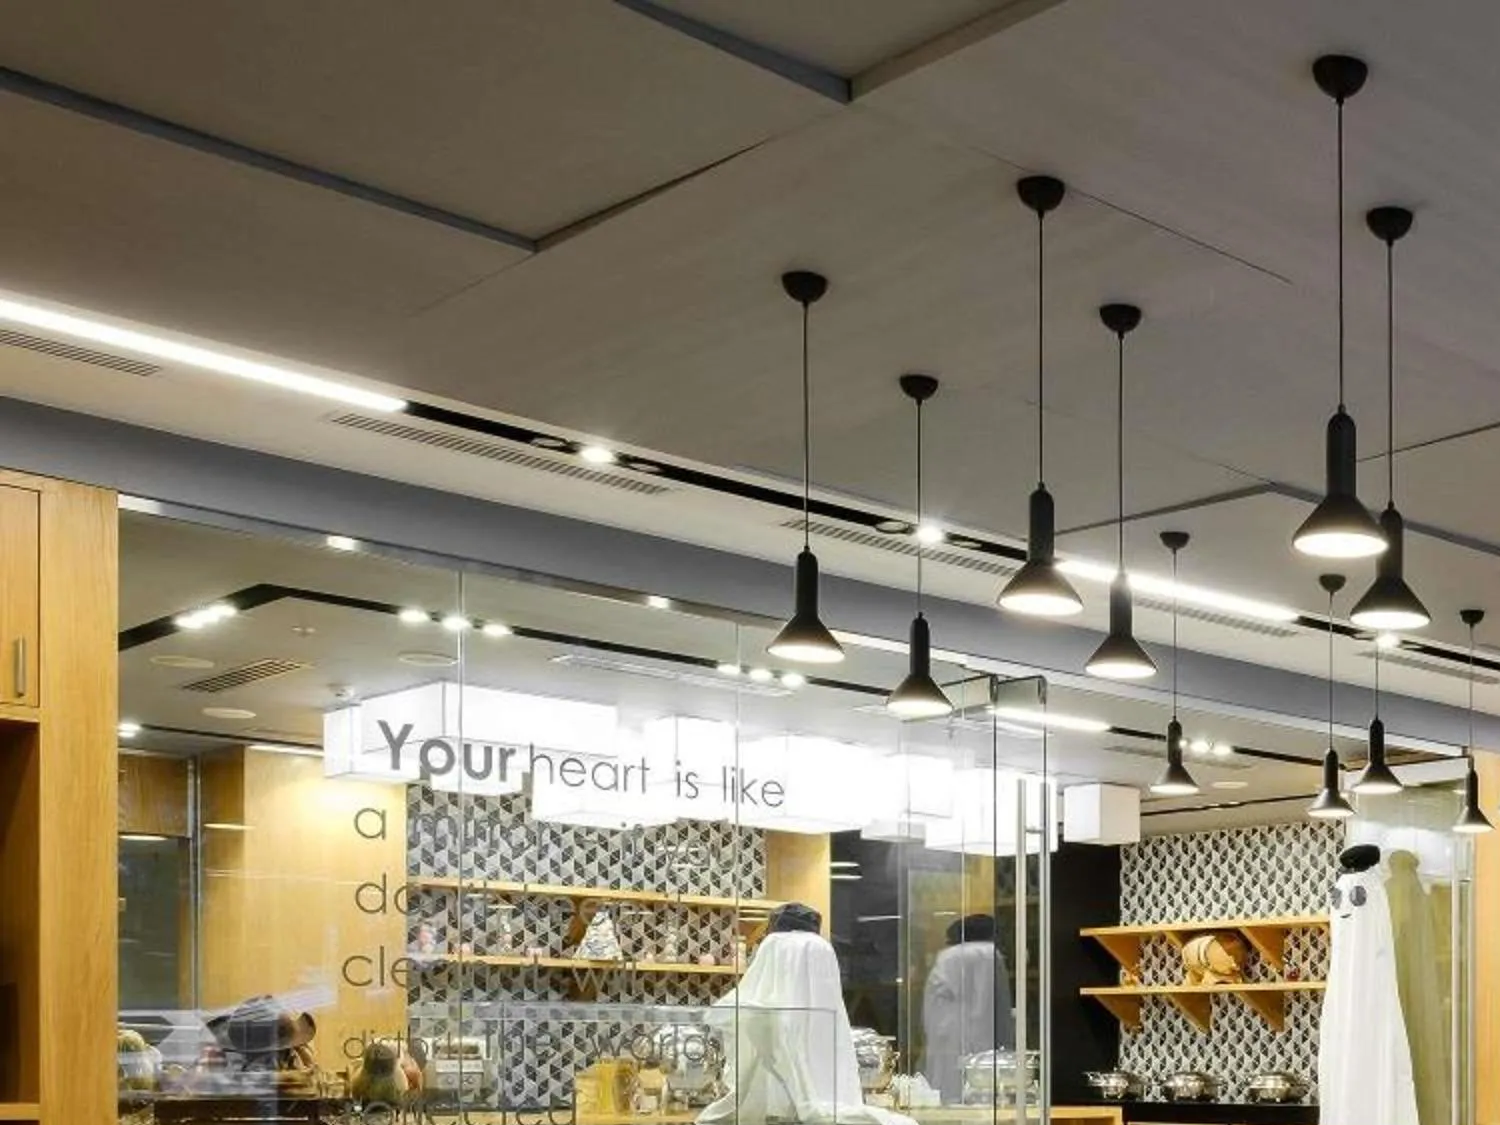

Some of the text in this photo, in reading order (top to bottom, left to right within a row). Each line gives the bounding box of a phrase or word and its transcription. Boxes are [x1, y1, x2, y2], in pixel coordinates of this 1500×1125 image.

[378, 719, 785, 807] Your heart is like
[353, 807, 387, 839] a
